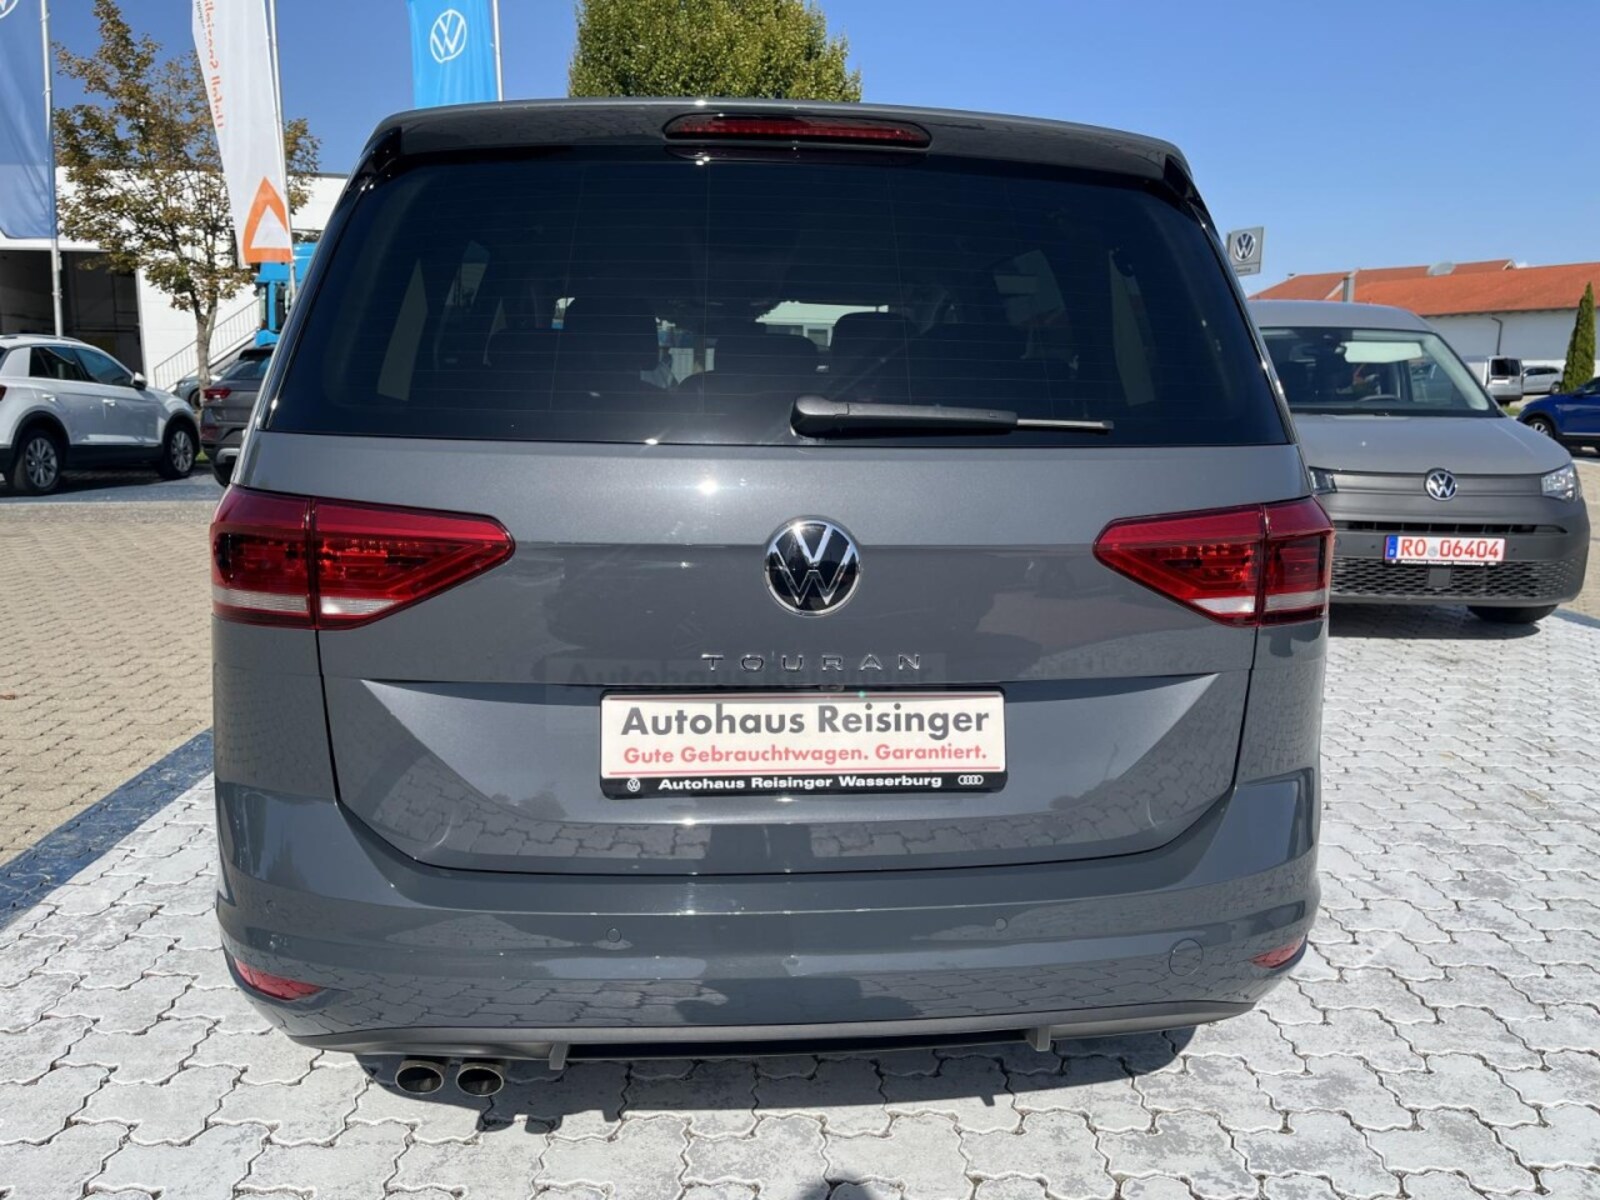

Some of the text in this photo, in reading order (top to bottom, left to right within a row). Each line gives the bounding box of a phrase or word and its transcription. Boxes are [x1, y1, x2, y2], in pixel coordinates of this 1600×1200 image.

[1400, 538, 1499, 558] RO 06404
[701, 653, 921, 671] TOURAN
[621, 703, 989, 741] Autohaus Reisinger
[624, 743, 987, 765] Gute Gebrauchtwagen. Garantiert.
[658, 775, 942, 790] Autohaus Reisinger Wasserburg
